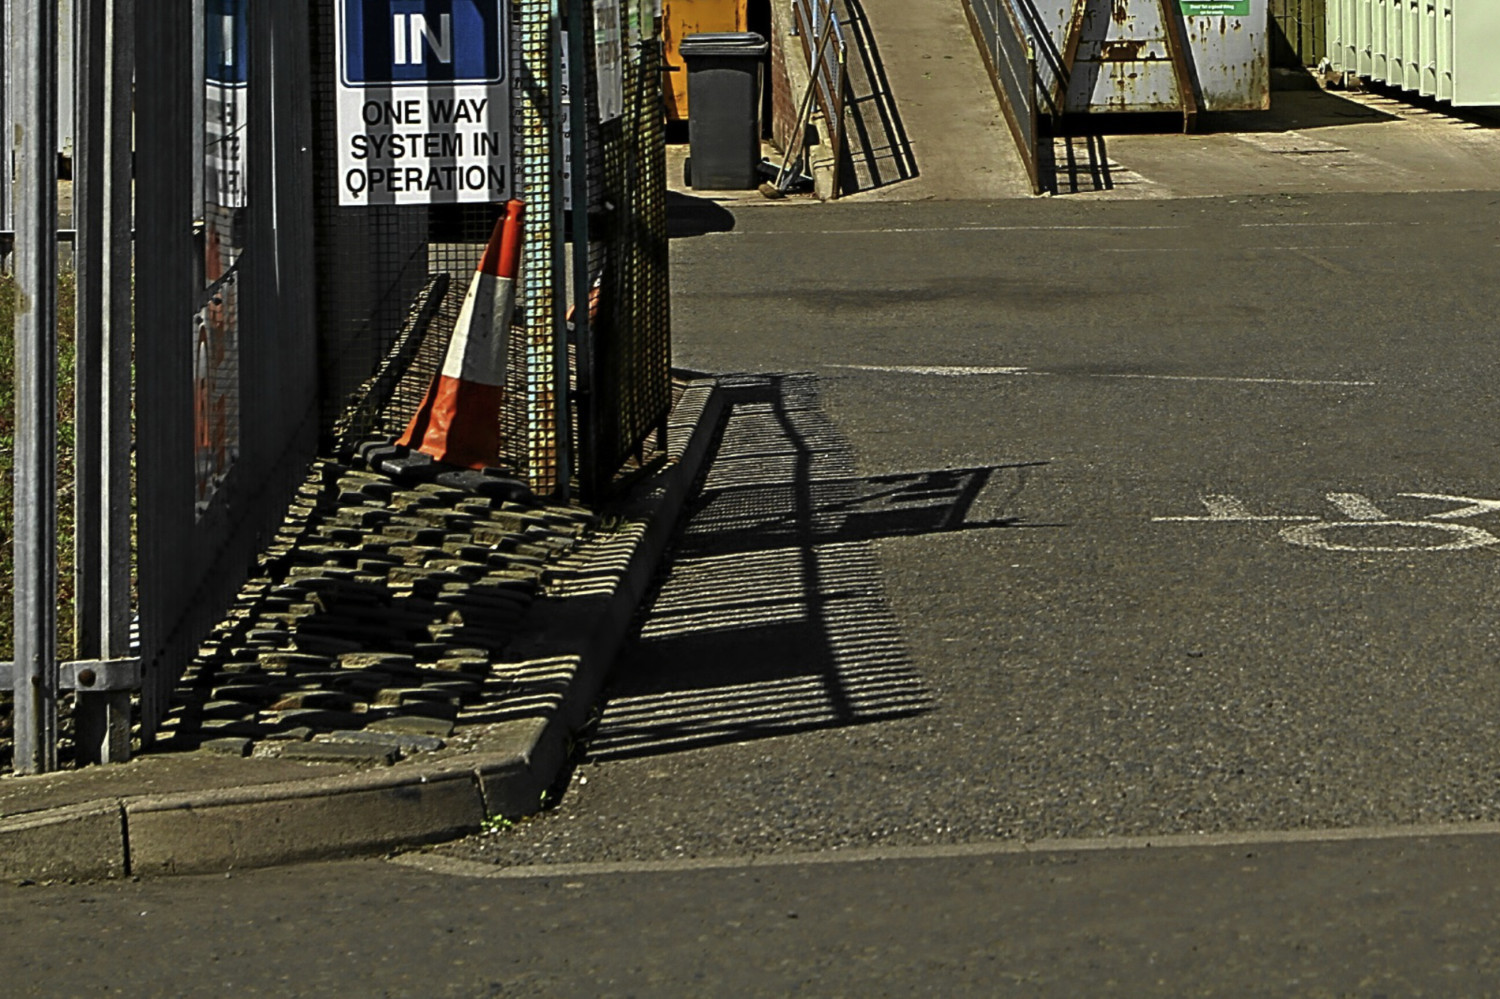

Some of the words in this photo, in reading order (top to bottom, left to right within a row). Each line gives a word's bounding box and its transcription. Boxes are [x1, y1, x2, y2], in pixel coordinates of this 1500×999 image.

[393, 13, 451, 64] IN
[362, 100, 421, 125] ONE
[428, 98, 487, 123] WAY
[351, 132, 462, 160] SYSTEM
[473, 131, 499, 157] IN
[346, 165, 505, 194] OPERATION
